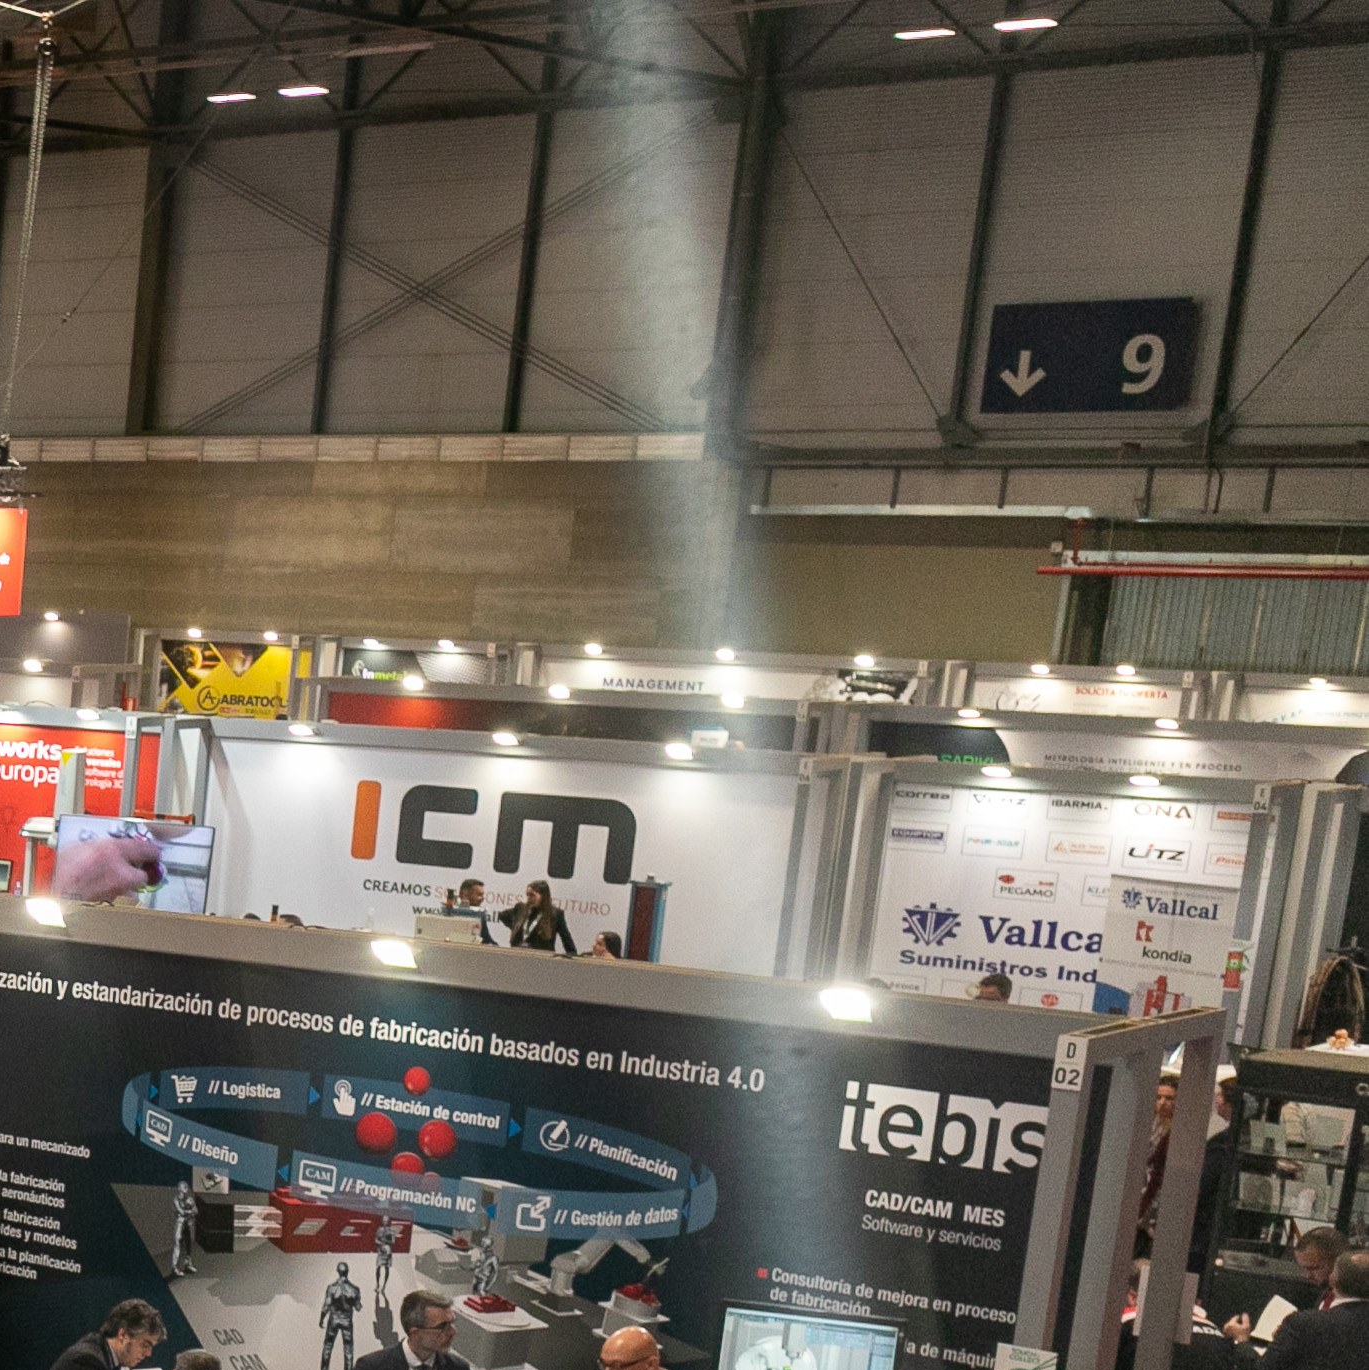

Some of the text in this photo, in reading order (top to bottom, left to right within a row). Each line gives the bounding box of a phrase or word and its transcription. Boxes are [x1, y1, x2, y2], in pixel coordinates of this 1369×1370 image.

[1121, 333, 1166, 395] 9
[602, 676, 705, 692] MANAGEMENT
[1075, 686, 1117, 696] SOLICITA
[1107, 757, 1167, 769] INTELIGENTE
[1178, 761, 1193, 769] EN
[1196, 762, 1242, 773] PROCESO
[1253, 800, 1268, 813] 04
[363, 879, 431, 897] CREAMOS
[999, 884, 1054, 898] PEGAMO
[1145, 895, 1218, 921] Vallcal
[979, 915, 1104, 954] Vallca
[899, 948, 1048, 979] Suministros
[1142, 946, 1192, 965] kondia
[56, 977, 68, 1001] y
[71, 980, 213, 1017] estandarización
[218, 997, 243, 1021] de
[246, 1001, 334, 1034] procesos
[338, 1013, 364, 1038] de
[370, 1014, 483, 1052] fabricación
[490, 1032, 580, 1066] basados
[586, 1050, 613, 1071] en
[620, 1050, 720, 1087] Industria
[727, 1064, 766, 1091] 4.0
[1066, 1042, 1076, 1058] D
[1055, 1067, 1080, 1086] 02
[222, 1081, 281, 1102] Logística
[375, 1094, 500, 1130] Estación de control
[16, 1137, 29, 1148] un
[31, 1139, 90, 1158] mecanizado
[191, 1134, 239, 1166] Diseño
[588, 1135, 679, 1181] Planificación
[0, 1170, 7, 1182] la
[10, 1171, 65, 1193] fabricación
[1, 1187, 65, 1208] aeronáuticos
[354, 1179, 477, 1214] Programación NC
[3, 1208, 60, 1230] fabricación
[570, 1205, 678, 1227] Gestión de datos
[864, 1188, 1006, 1229] CAD/CAM MES
[24, 1230, 30, 1243] y
[33, 1231, 77, 1250] modelos
[860, 1214, 1003, 1252] Software y servicios
[8, 1248, 16, 1259] la
[19, 1251, 81, 1274] planificación
[769, 1287, 871, 1316] de fabricación
[771, 1267, 1016, 1324] Consultoría de mejora en proceso
[212, 1329, 245, 1346] CAD
[919, 1343, 939, 1359] de
